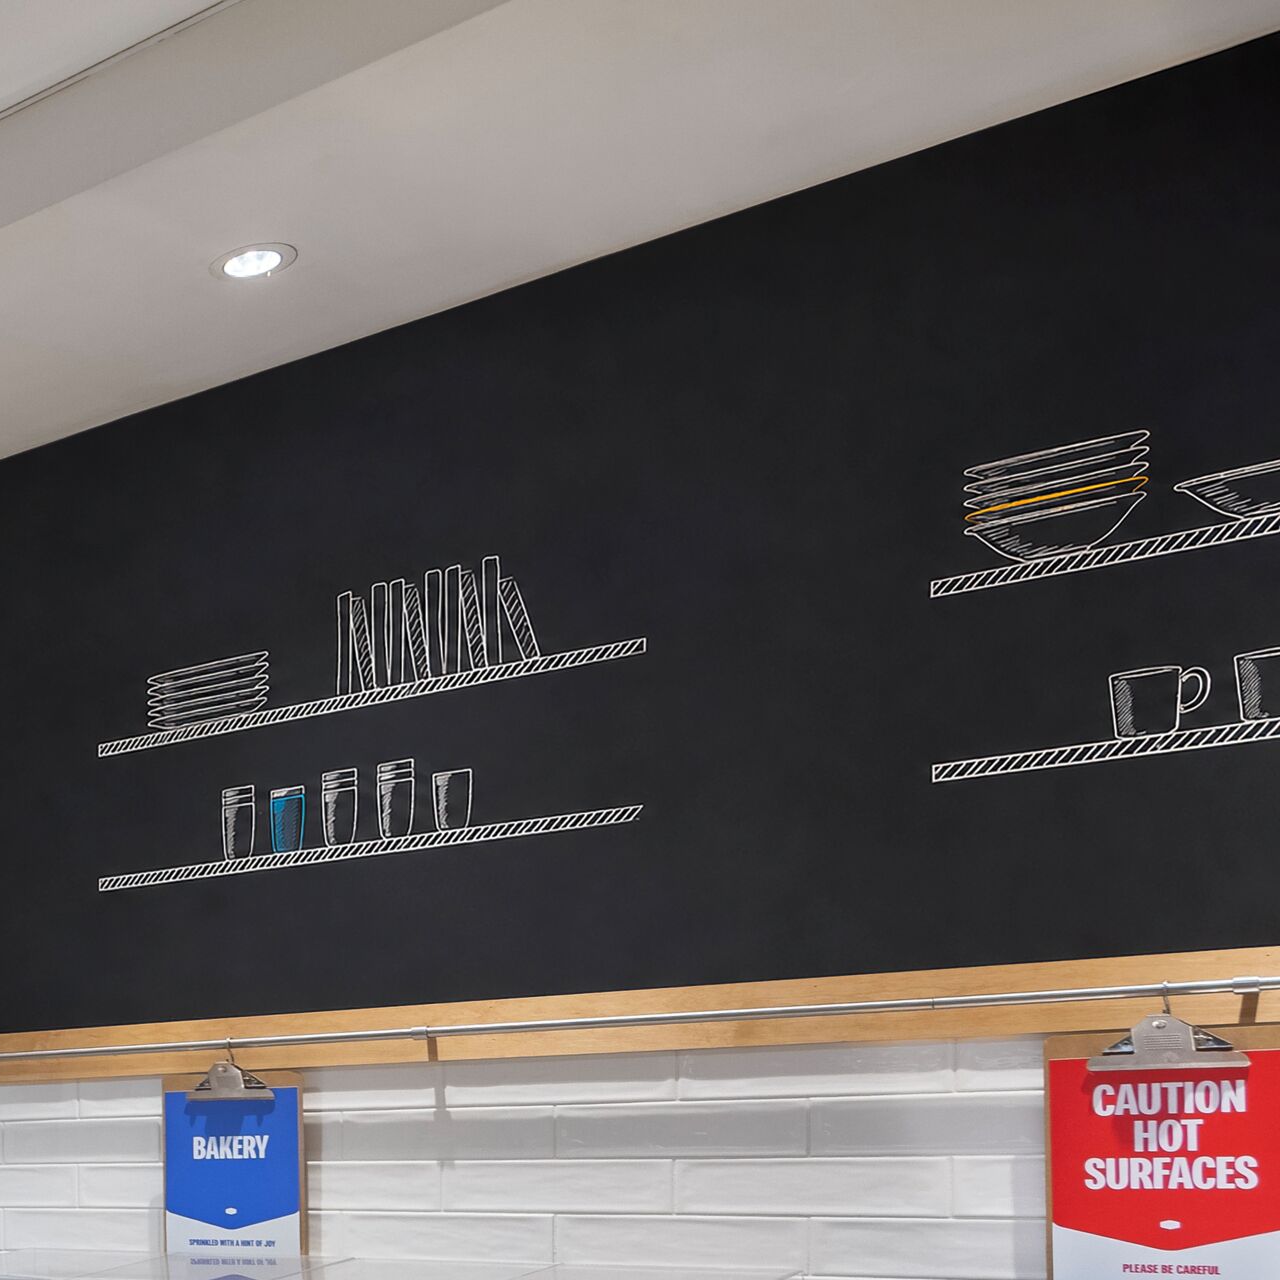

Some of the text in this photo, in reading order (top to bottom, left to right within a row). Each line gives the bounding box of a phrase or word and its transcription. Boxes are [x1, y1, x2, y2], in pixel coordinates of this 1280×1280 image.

[1092, 1079, 1247, 1117] CAUTION
[192, 1135, 270, 1160] BAKERY
[1133, 1118, 1204, 1152] HOT
[1083, 1155, 1260, 1190] SURFACES
[189, 1239, 218, 1247] SPRINKLED
[220, 1239, 234, 1247] WITH
[264, 1240, 276, 1248] JOY
[1122, 1263, 1221, 1275] PLEASE BE CAREFUL
